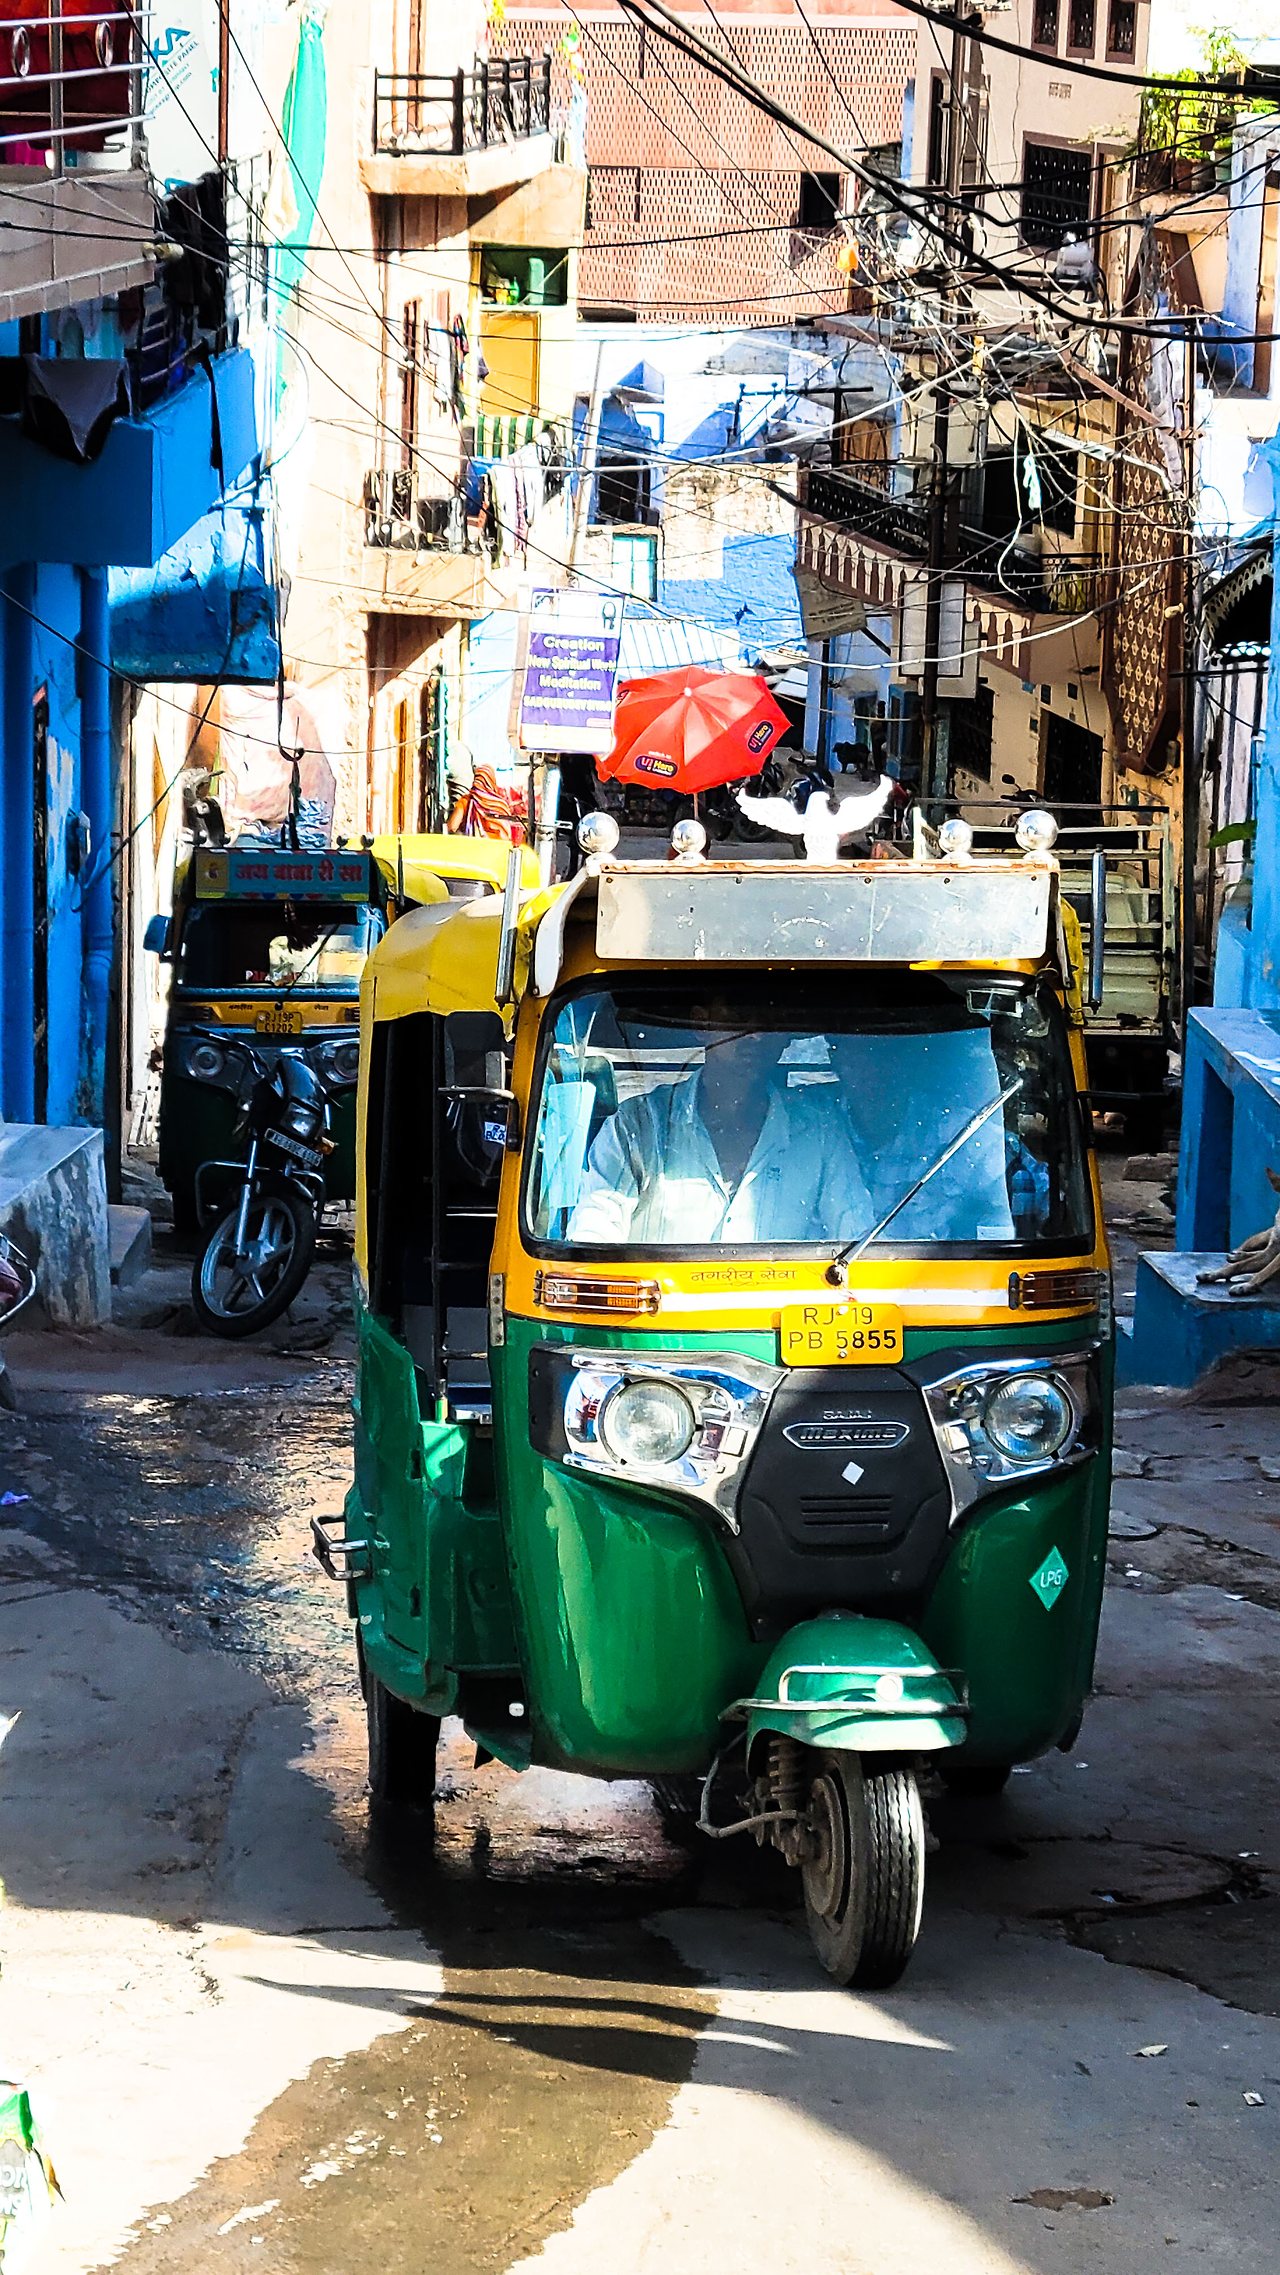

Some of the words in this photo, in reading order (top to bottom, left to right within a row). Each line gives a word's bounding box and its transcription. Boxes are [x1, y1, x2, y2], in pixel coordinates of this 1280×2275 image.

[177, 40, 200, 62] PANEL
[543, 636, 605, 651] Creation
[528, 654, 551, 668] New
[539, 674, 602, 691] Meditation
[754, 725, 769, 740] Hero
[654, 760, 674, 772] Hero
[236, 864, 269, 881] जय
[273, 864, 314, 882] बाबा
[265, 1012, 294, 1023] RJ19P
[265, 1022, 294, 1033] C1202
[691, 1268, 755, 1282] नगरीय
[760, 1267, 797, 1281] सेवा
[804, 1307, 835, 1326] RJ
[852, 1307, 873, 1325] 19
[789, 1331, 823, 1350] PB
[836, 1330, 897, 1350] 5855
[1040, 1569, 1063, 1588] LPG
